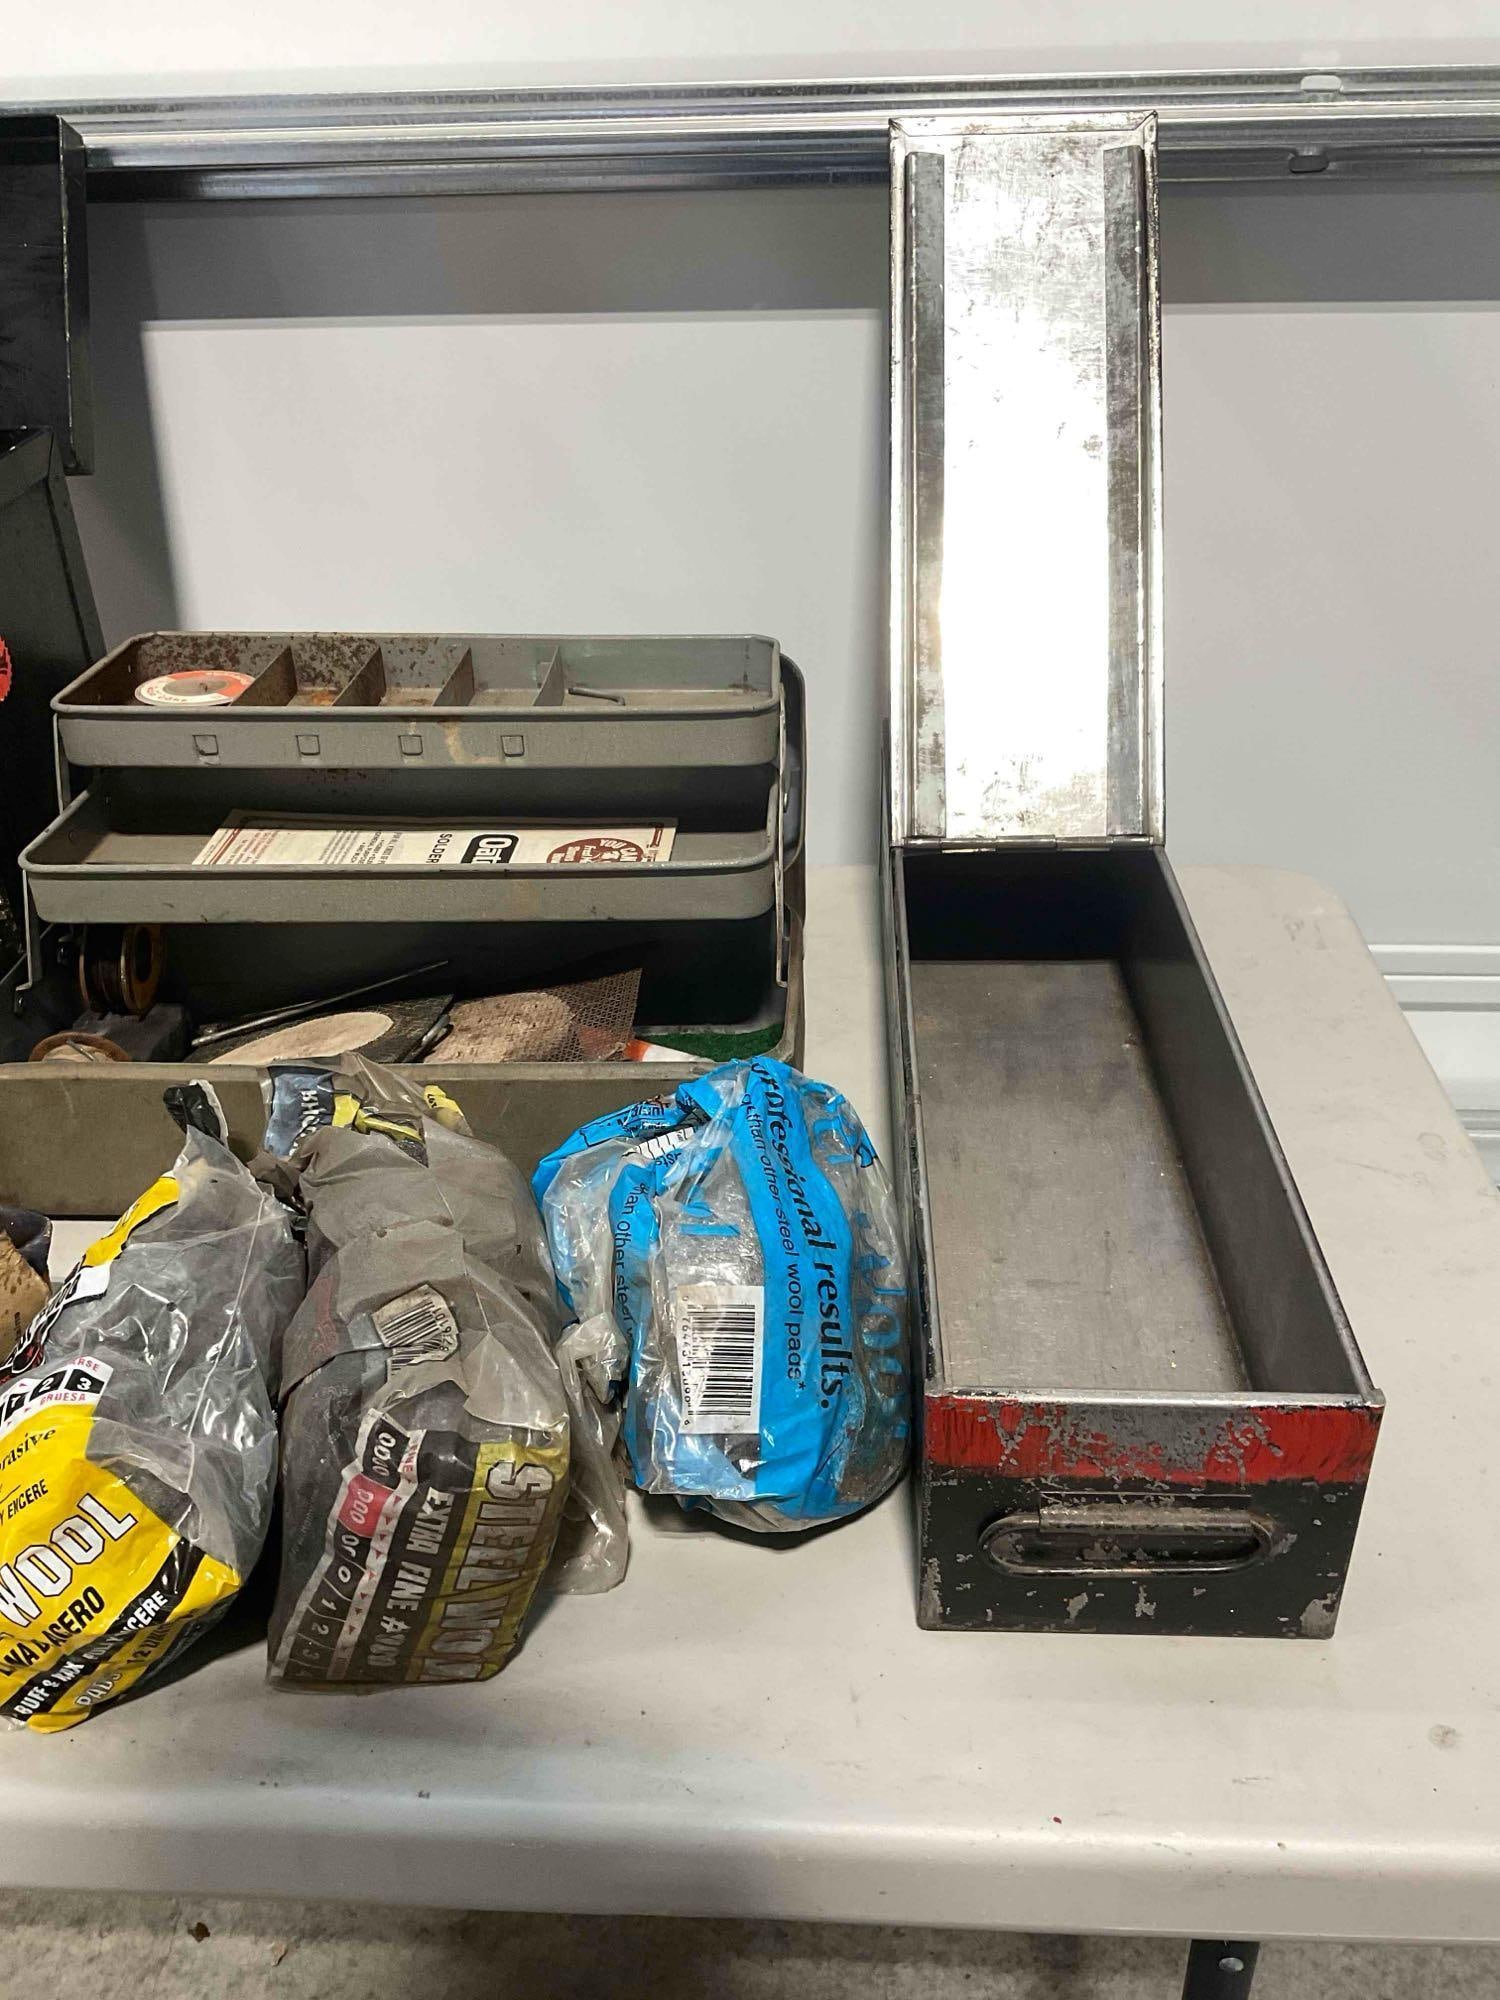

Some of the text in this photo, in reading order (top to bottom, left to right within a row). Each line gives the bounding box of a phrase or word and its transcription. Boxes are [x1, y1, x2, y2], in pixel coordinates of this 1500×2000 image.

[425, 833, 453, 864] SOLDER
[471, 837, 513, 864] Oat
[760, 1154, 783, 1204] other
[615, 1219, 632, 1276] other
[775, 1206, 800, 1258] steel
[787, 1262, 802, 1315] wool
[813, 1259, 853, 1410] results.
[38, 1377, 54, 1392] 2
[77, 1377, 92, 1391] 3
[0, 1429, 56, 1471] rasive
[406, 1486, 455, 1555] EXTRA
[454, 1459, 556, 1592] STEEL
[0, 1492, 138, 1628] WOOL
[387, 1560, 433, 1612] FINE
[42, 1585, 105, 1648] ACERO
[115, 1590, 169, 1636] NCERE
[14, 1686, 51, 1717] BUFF
[52, 1660, 86, 1683] WAX
